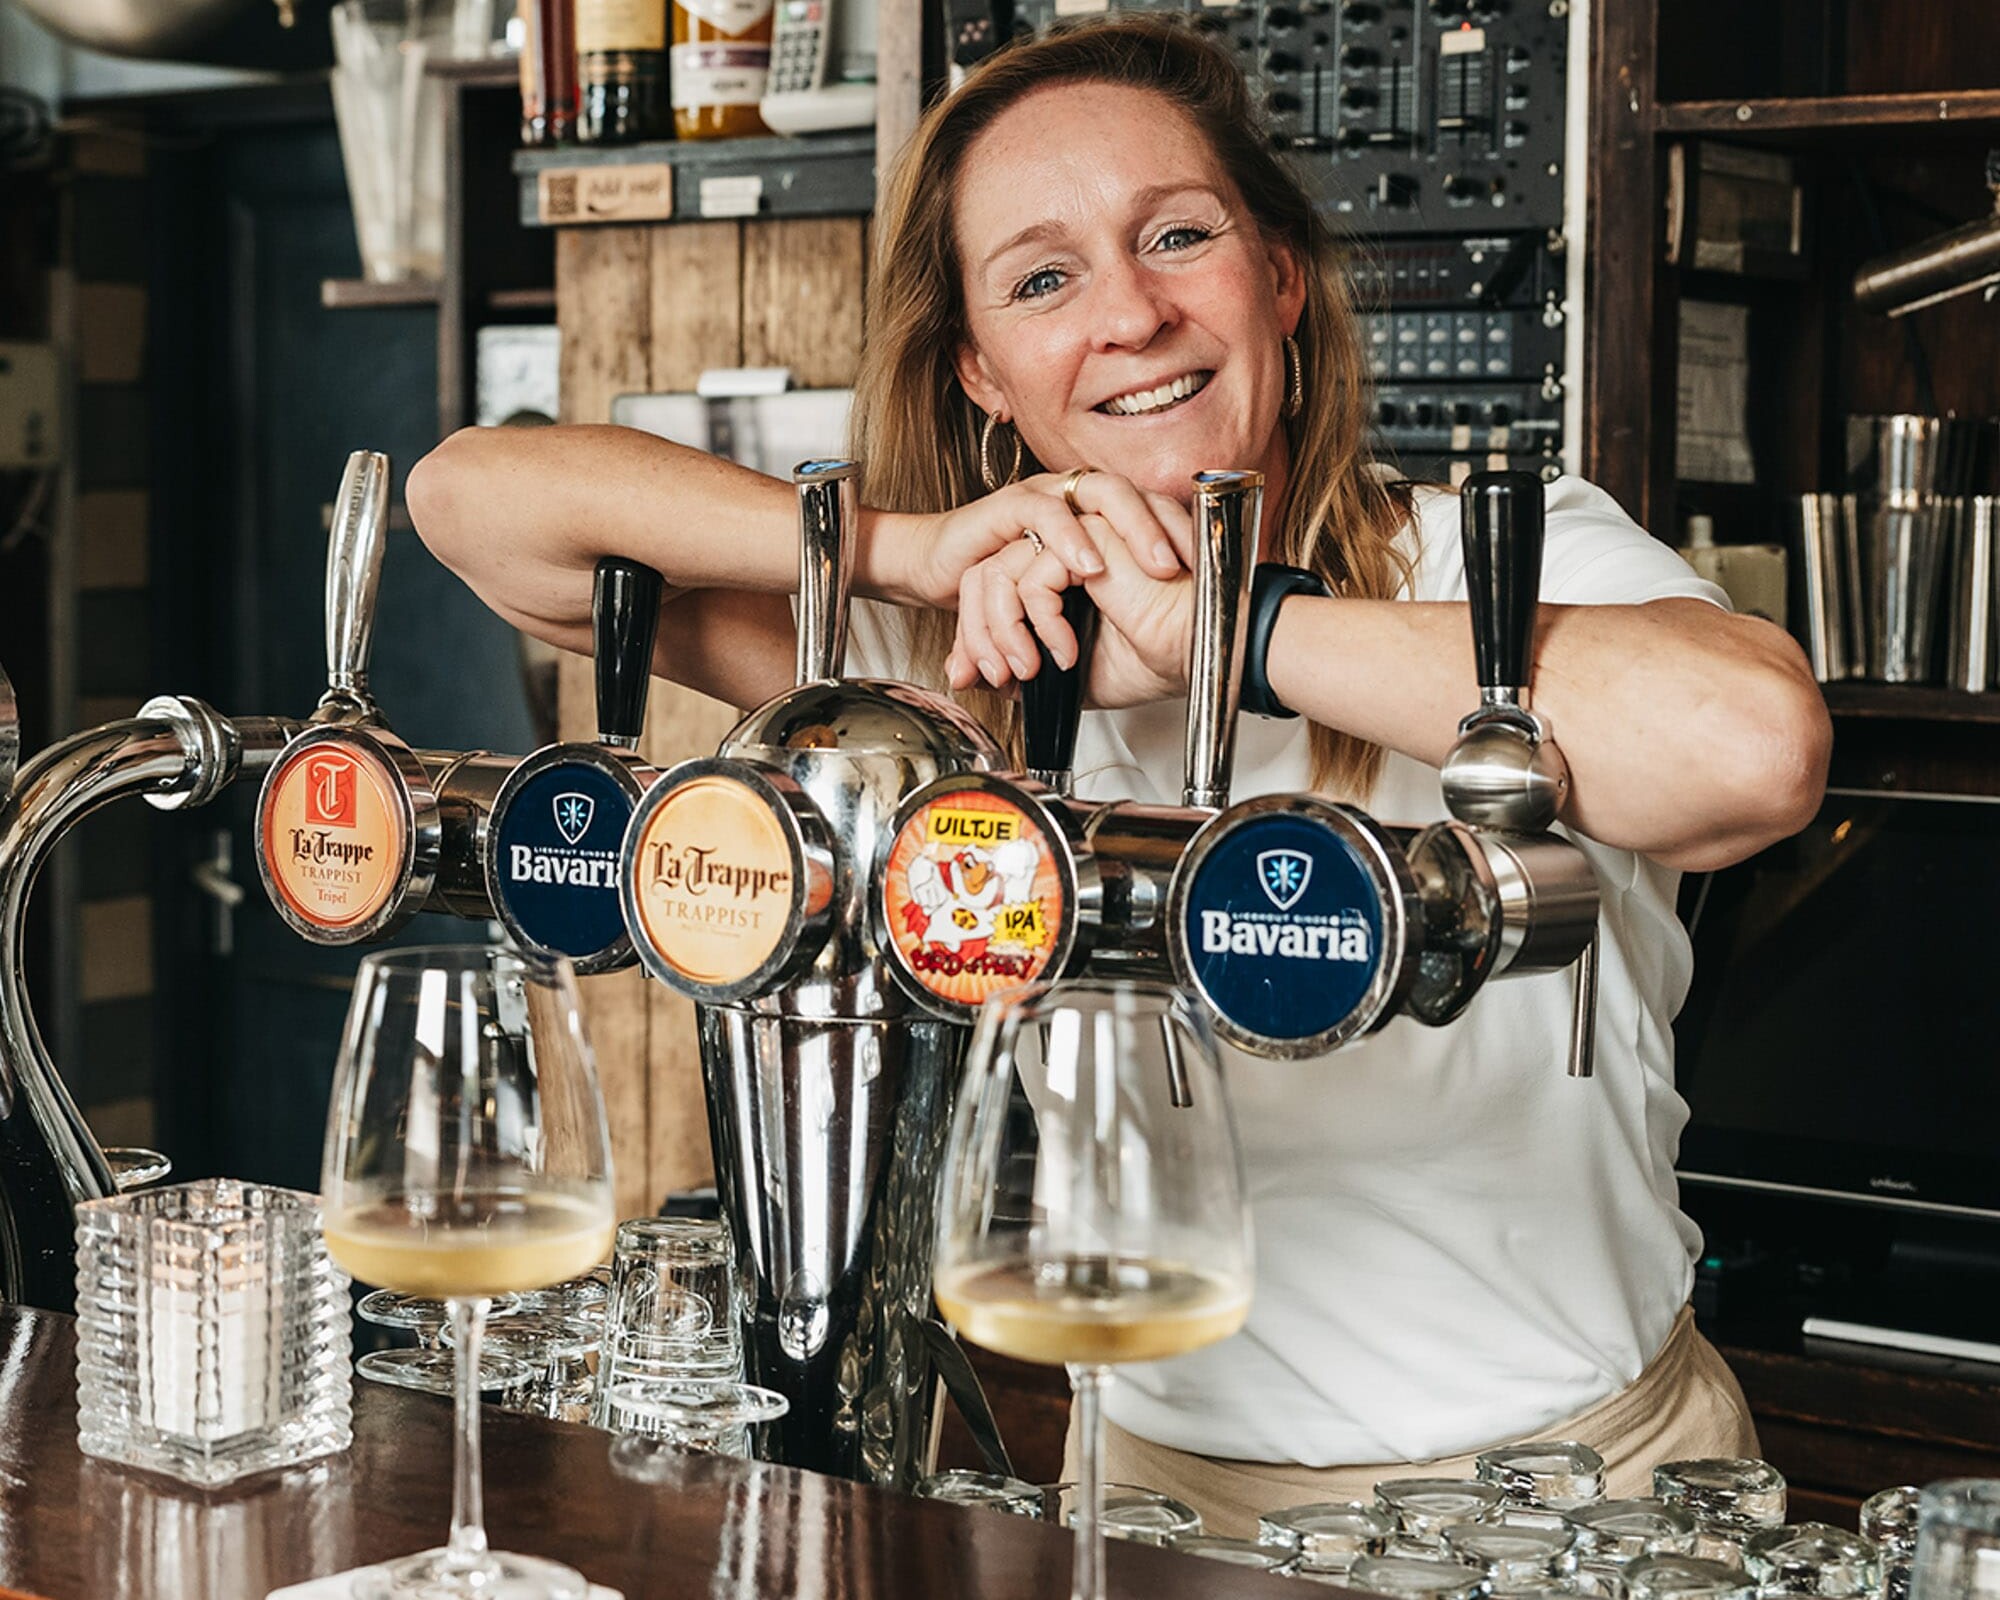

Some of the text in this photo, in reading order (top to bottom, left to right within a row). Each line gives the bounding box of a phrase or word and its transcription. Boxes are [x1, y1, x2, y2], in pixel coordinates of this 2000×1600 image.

[935, 816, 1012, 840] UILTJE
[311, 831, 374, 866] Trappe
[300, 865, 362, 884] TRAPPIST
[317, 888, 347, 904] Tripel
[663, 899, 763, 929] TRAPPIST
[1005, 910, 1036, 931] IPA
[1200, 910, 1369, 962] Bavaria
